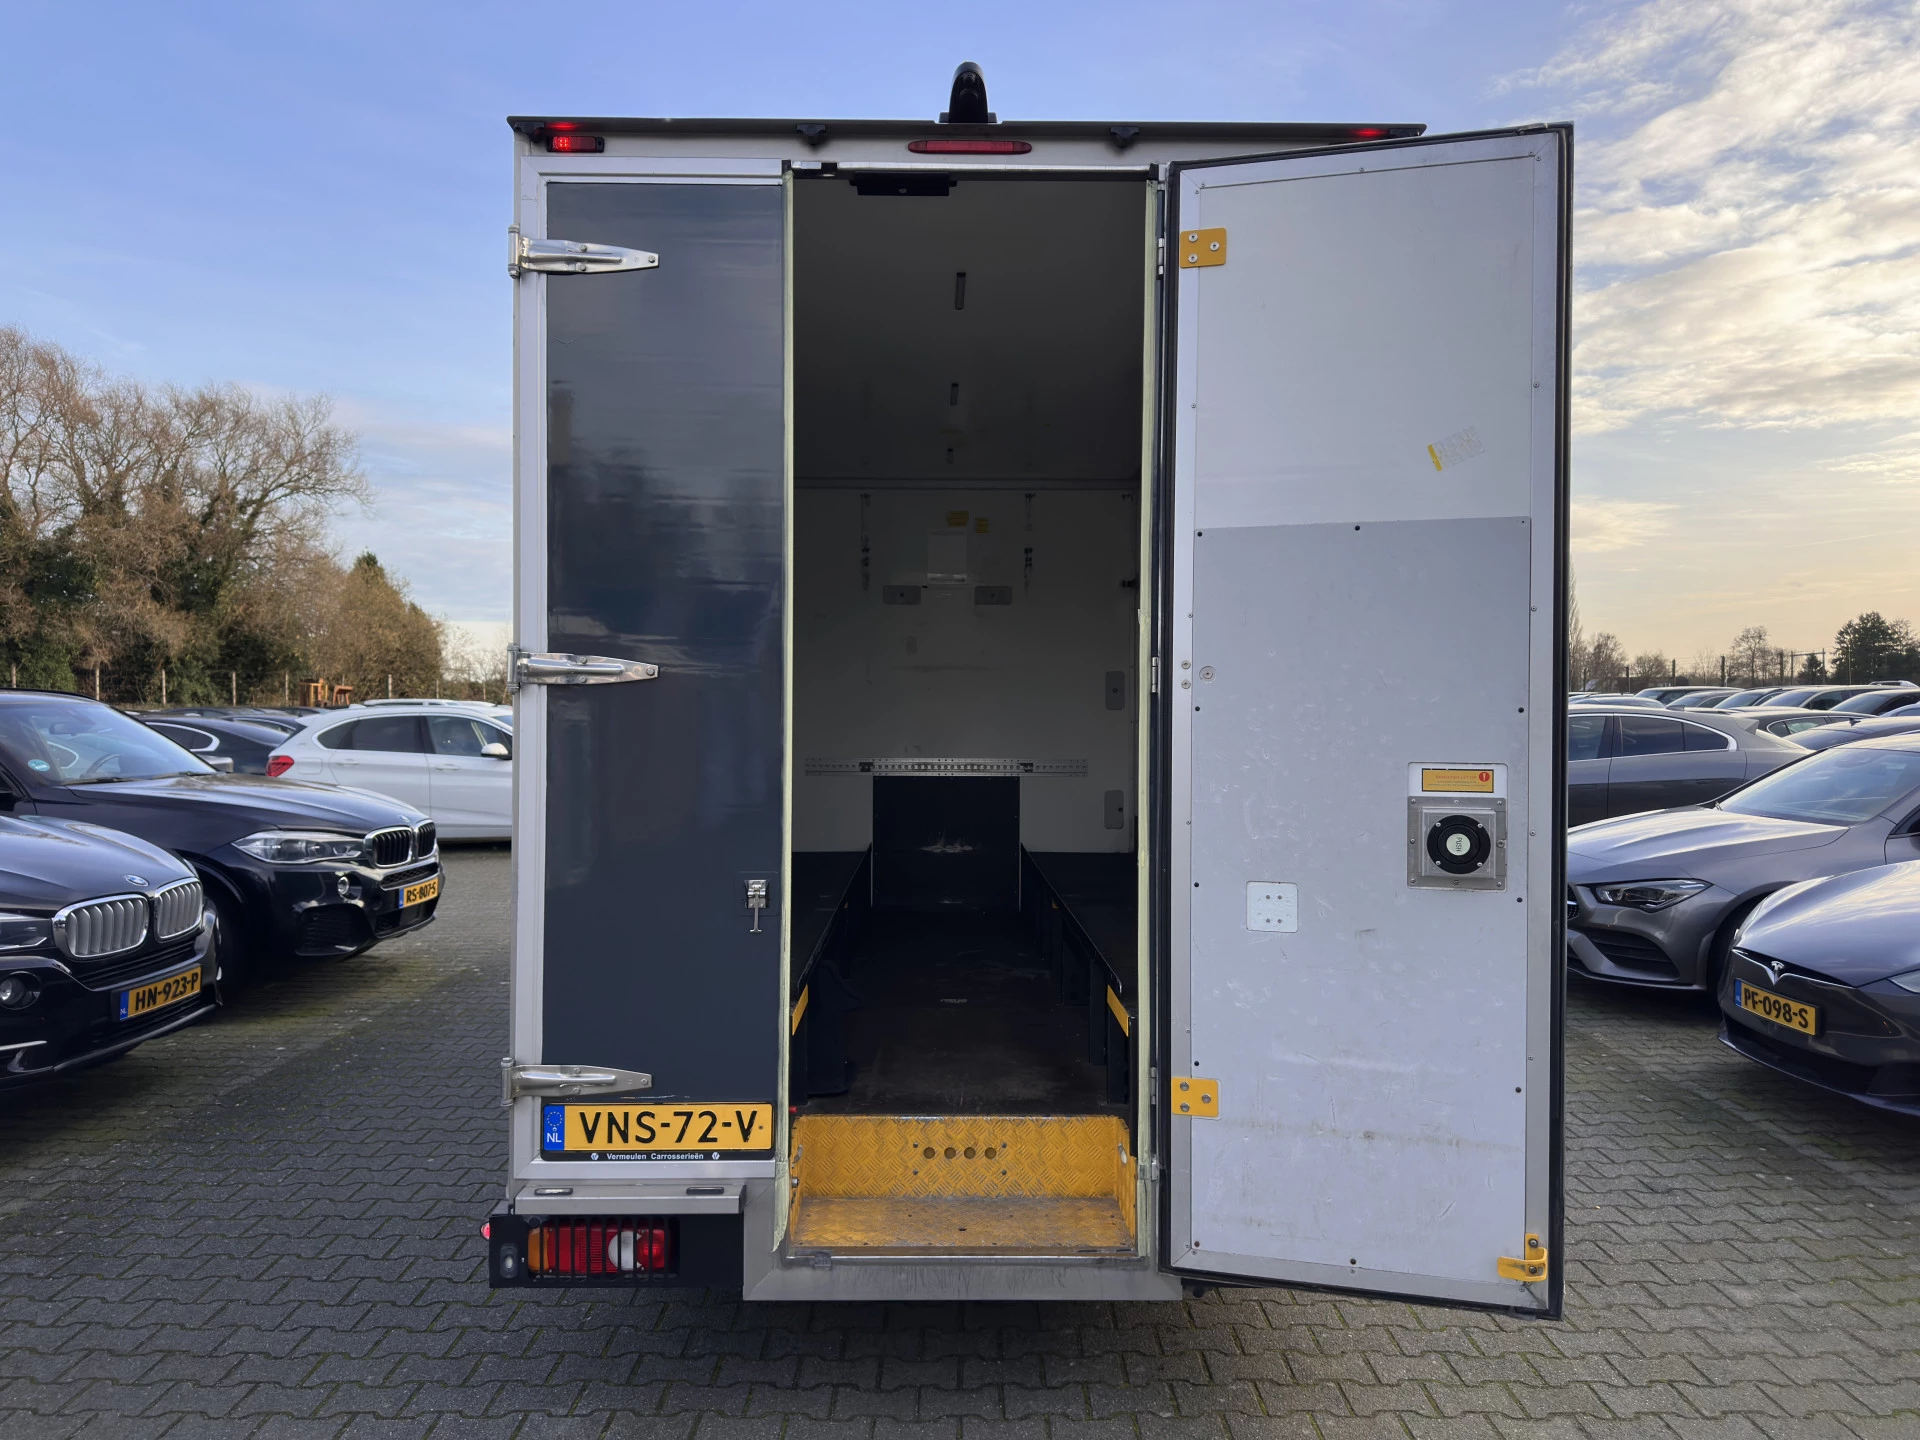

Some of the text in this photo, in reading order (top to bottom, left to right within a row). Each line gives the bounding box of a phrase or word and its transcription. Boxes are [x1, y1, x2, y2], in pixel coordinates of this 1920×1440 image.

[1455, 837, 1463, 852] PUSH
[135, 972, 199, 1011] HN-923-P
[1744, 987, 1808, 1029] PF-098-S
[546, 1133, 562, 1143] NL
[579, 1110, 758, 1144] VNS-72-V
[606, 1152, 704, 1160] Vermeulen Carrosserieën
